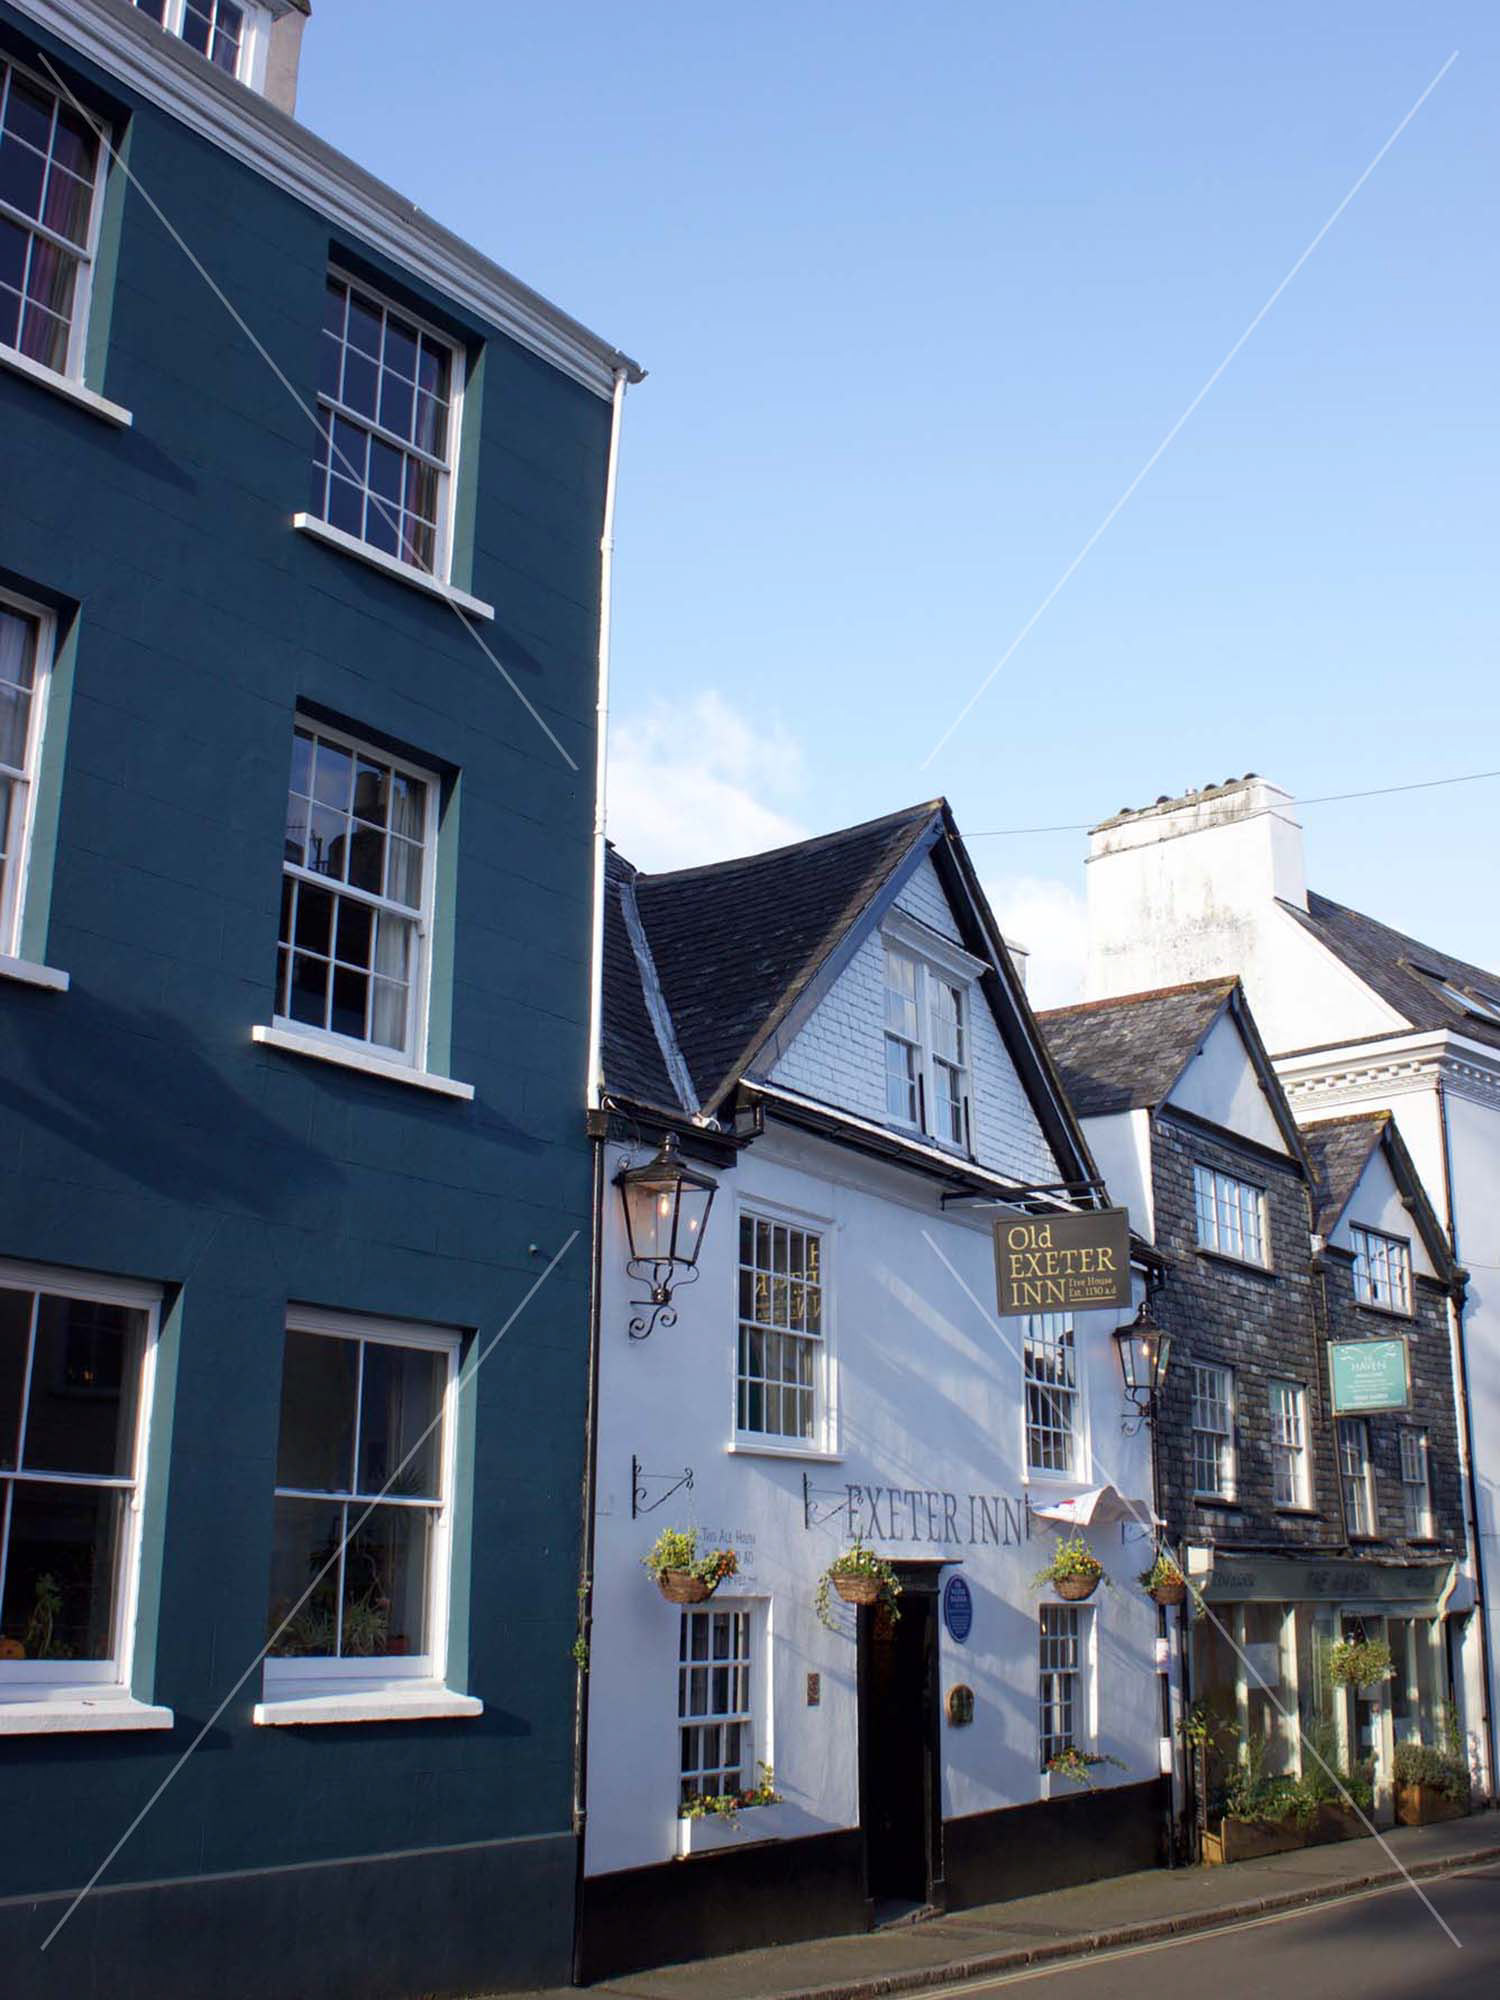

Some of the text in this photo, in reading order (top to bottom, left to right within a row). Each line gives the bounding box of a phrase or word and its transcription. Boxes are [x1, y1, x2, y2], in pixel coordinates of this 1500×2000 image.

[1008, 1224, 1053, 1250] Old
[1008, 1247, 1117, 1279] EXETER
[1011, 1278, 1066, 1306] INN
[844, 1484, 1025, 1547] EXETER INN
